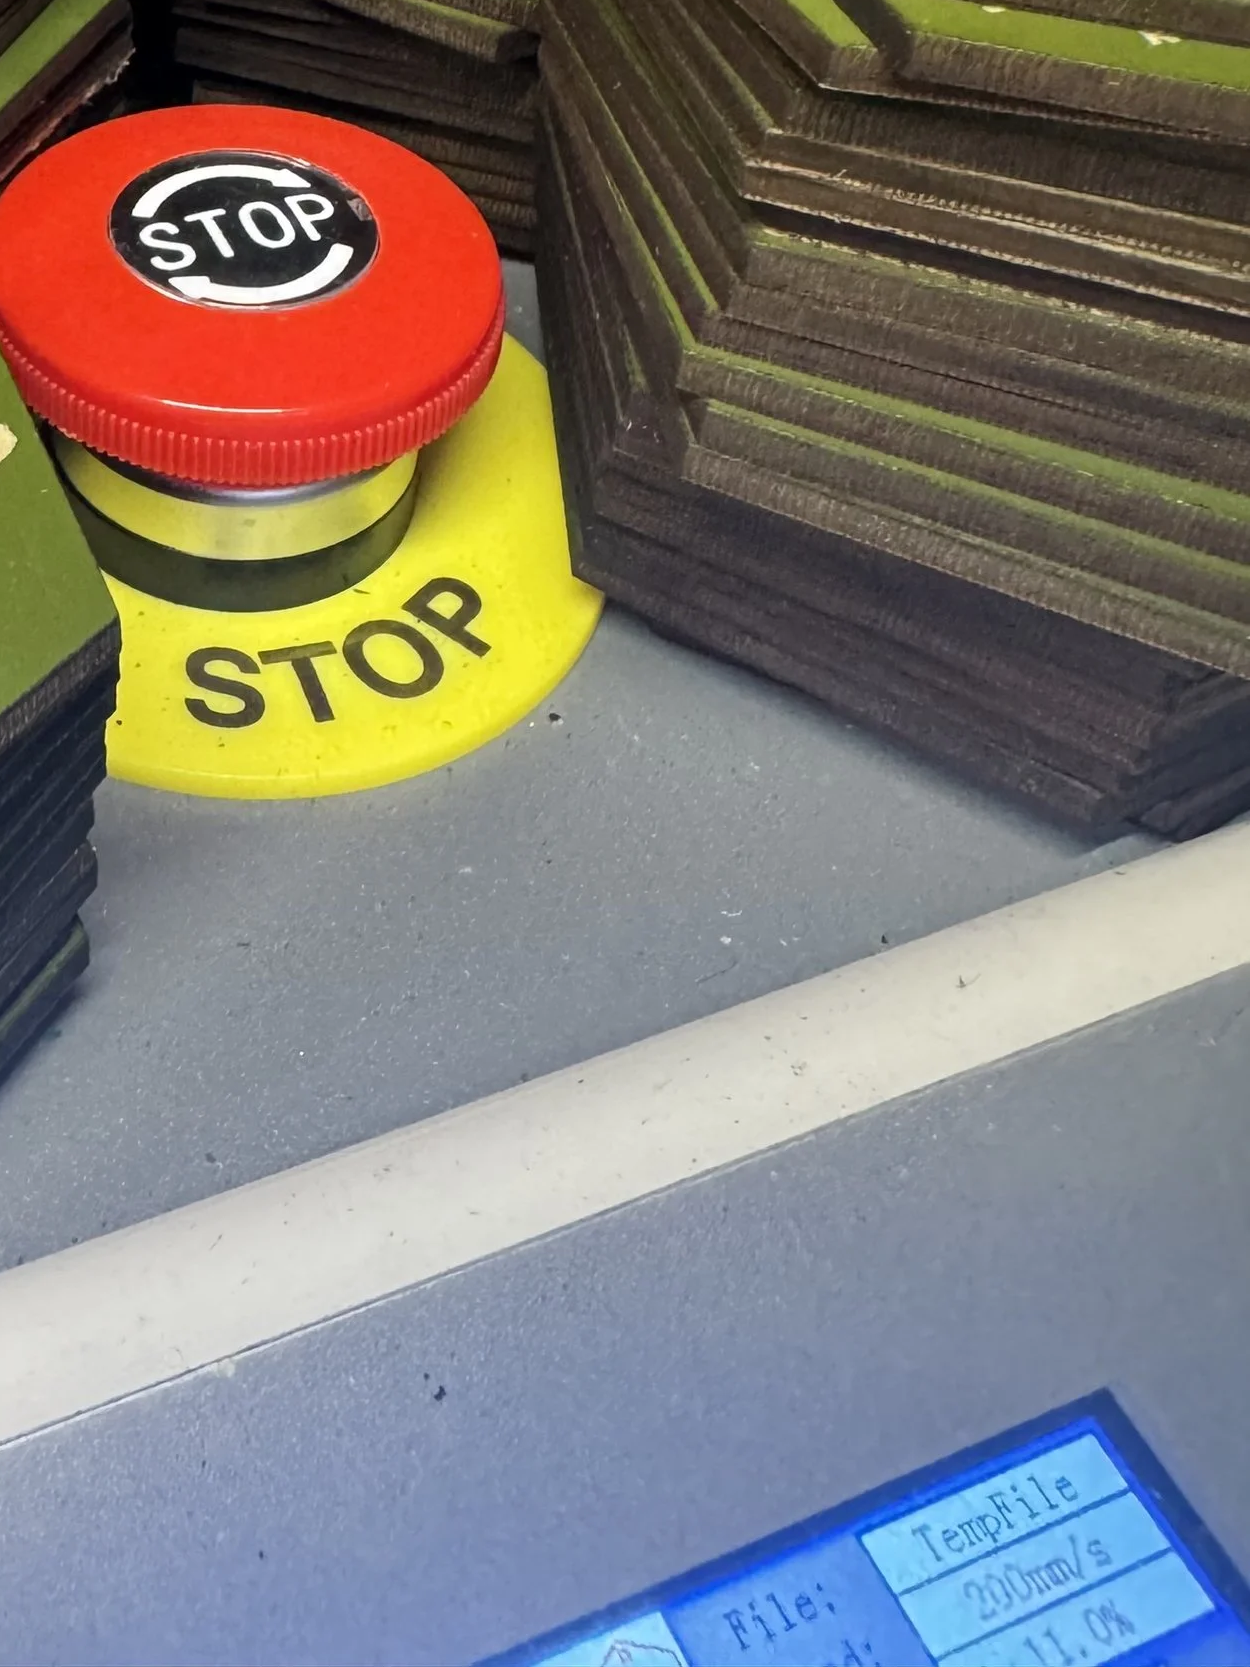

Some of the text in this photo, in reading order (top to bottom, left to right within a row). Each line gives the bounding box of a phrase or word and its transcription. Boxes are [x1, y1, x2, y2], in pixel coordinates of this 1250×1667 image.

[138, 193, 336, 272] STOP
[183, 576, 493, 729] STOP
[911, 1472, 1079, 1563] TempFile
[722, 1582, 836, 1652] File:
[963, 1533, 1113, 1621] 200mm/s
